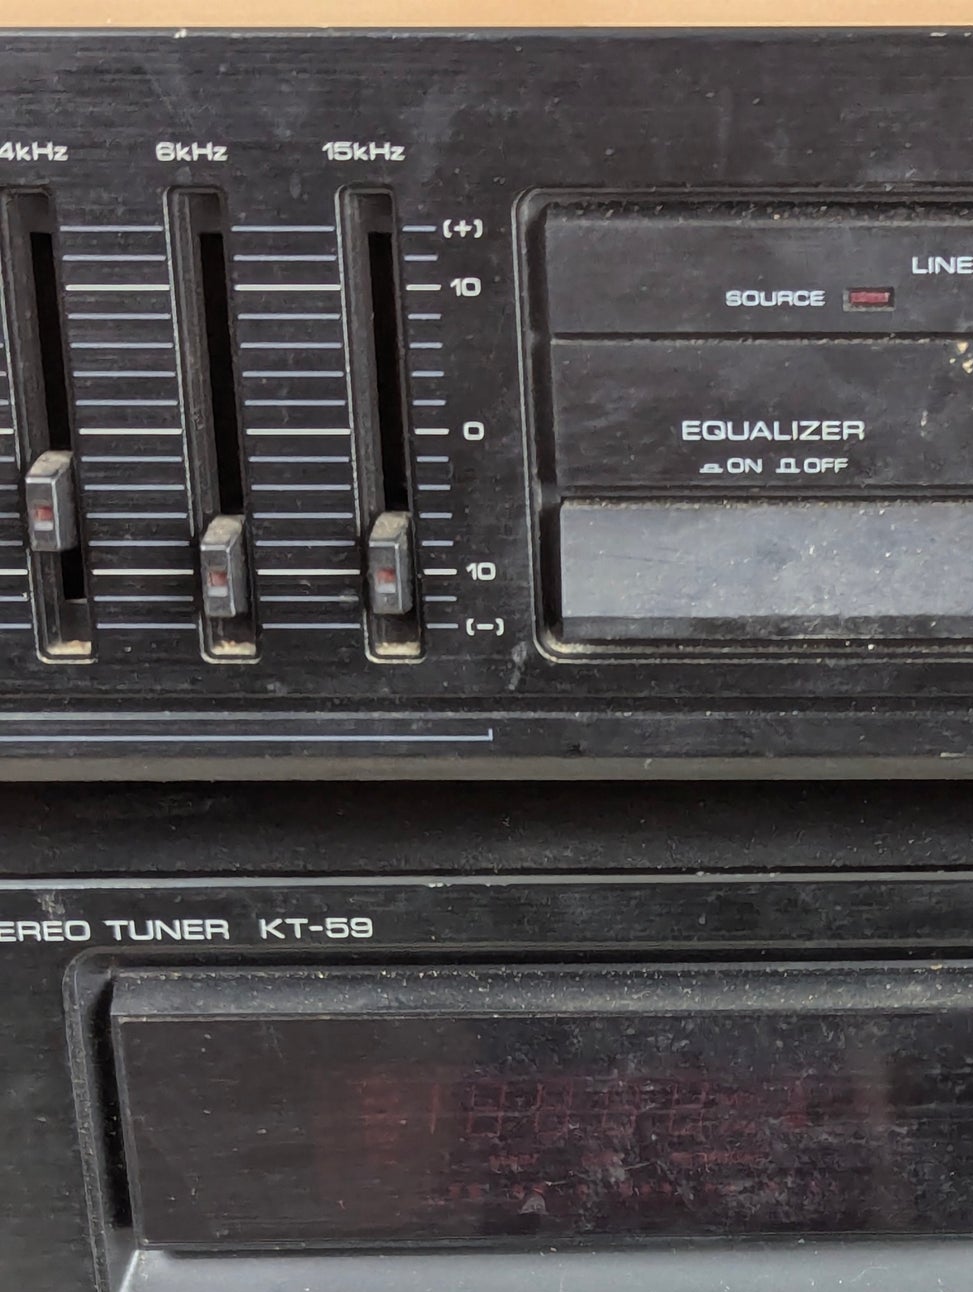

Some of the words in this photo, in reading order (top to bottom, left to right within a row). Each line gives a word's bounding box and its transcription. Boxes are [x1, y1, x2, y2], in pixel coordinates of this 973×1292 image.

[0, 141, 69, 161] 4kHz
[155, 141, 228, 162] 6kHz
[321, 141, 406, 161] 15kHz
[449, 277, 482, 297] 10
[725, 289, 826, 307] SOURCE
[462, 421, 485, 441] 0
[681, 420, 865, 441] EQUALIZER
[726, 457, 763, 474] ON
[803, 457, 849, 474] OFF
[465, 561, 497, 581] 10
[0, 920, 91, 942] EREO
[103, 918, 230, 941] TUNER
[259, 917, 373, 940] KT-59
